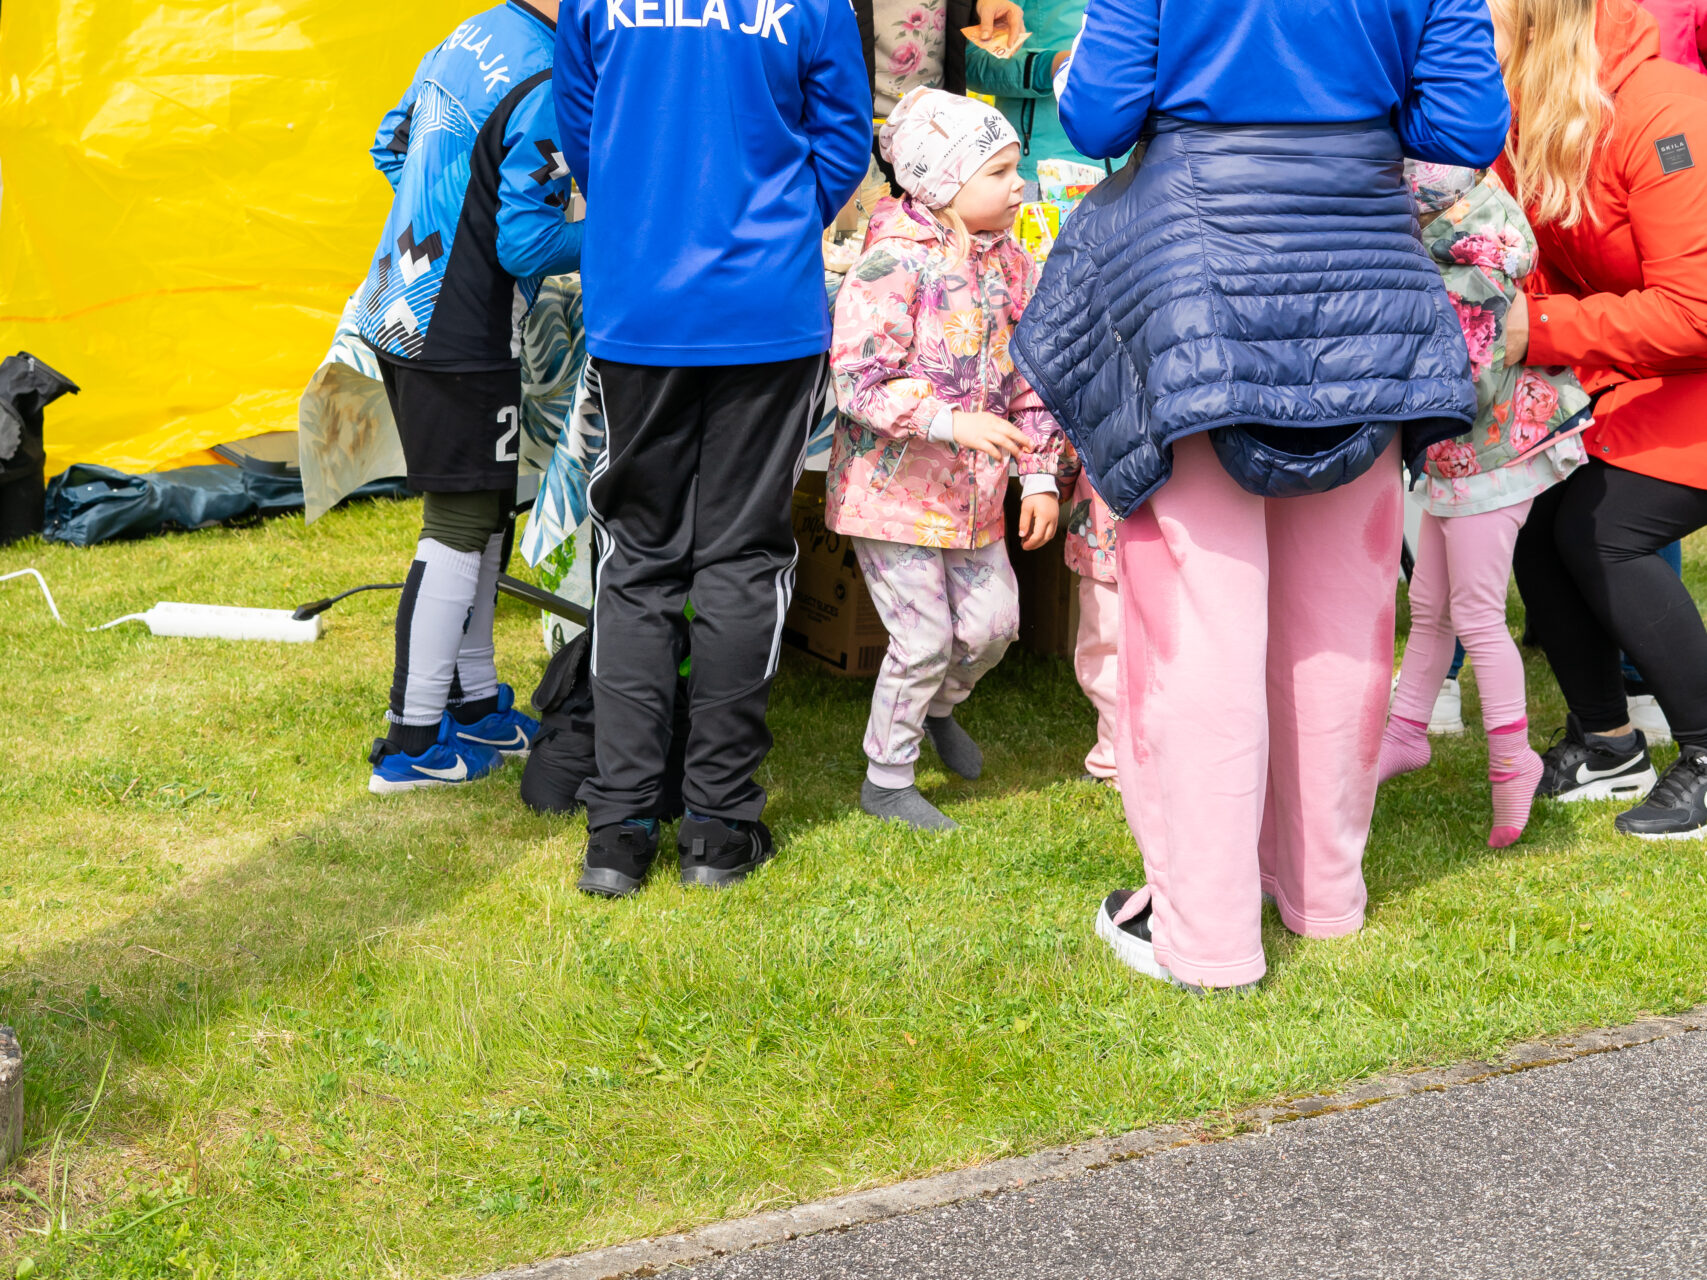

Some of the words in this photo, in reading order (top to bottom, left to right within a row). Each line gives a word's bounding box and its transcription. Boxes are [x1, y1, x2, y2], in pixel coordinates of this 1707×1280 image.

[992, 46, 1006, 56] 10
[479, 53, 510, 94] JK
[496, 405, 518, 462] 2
